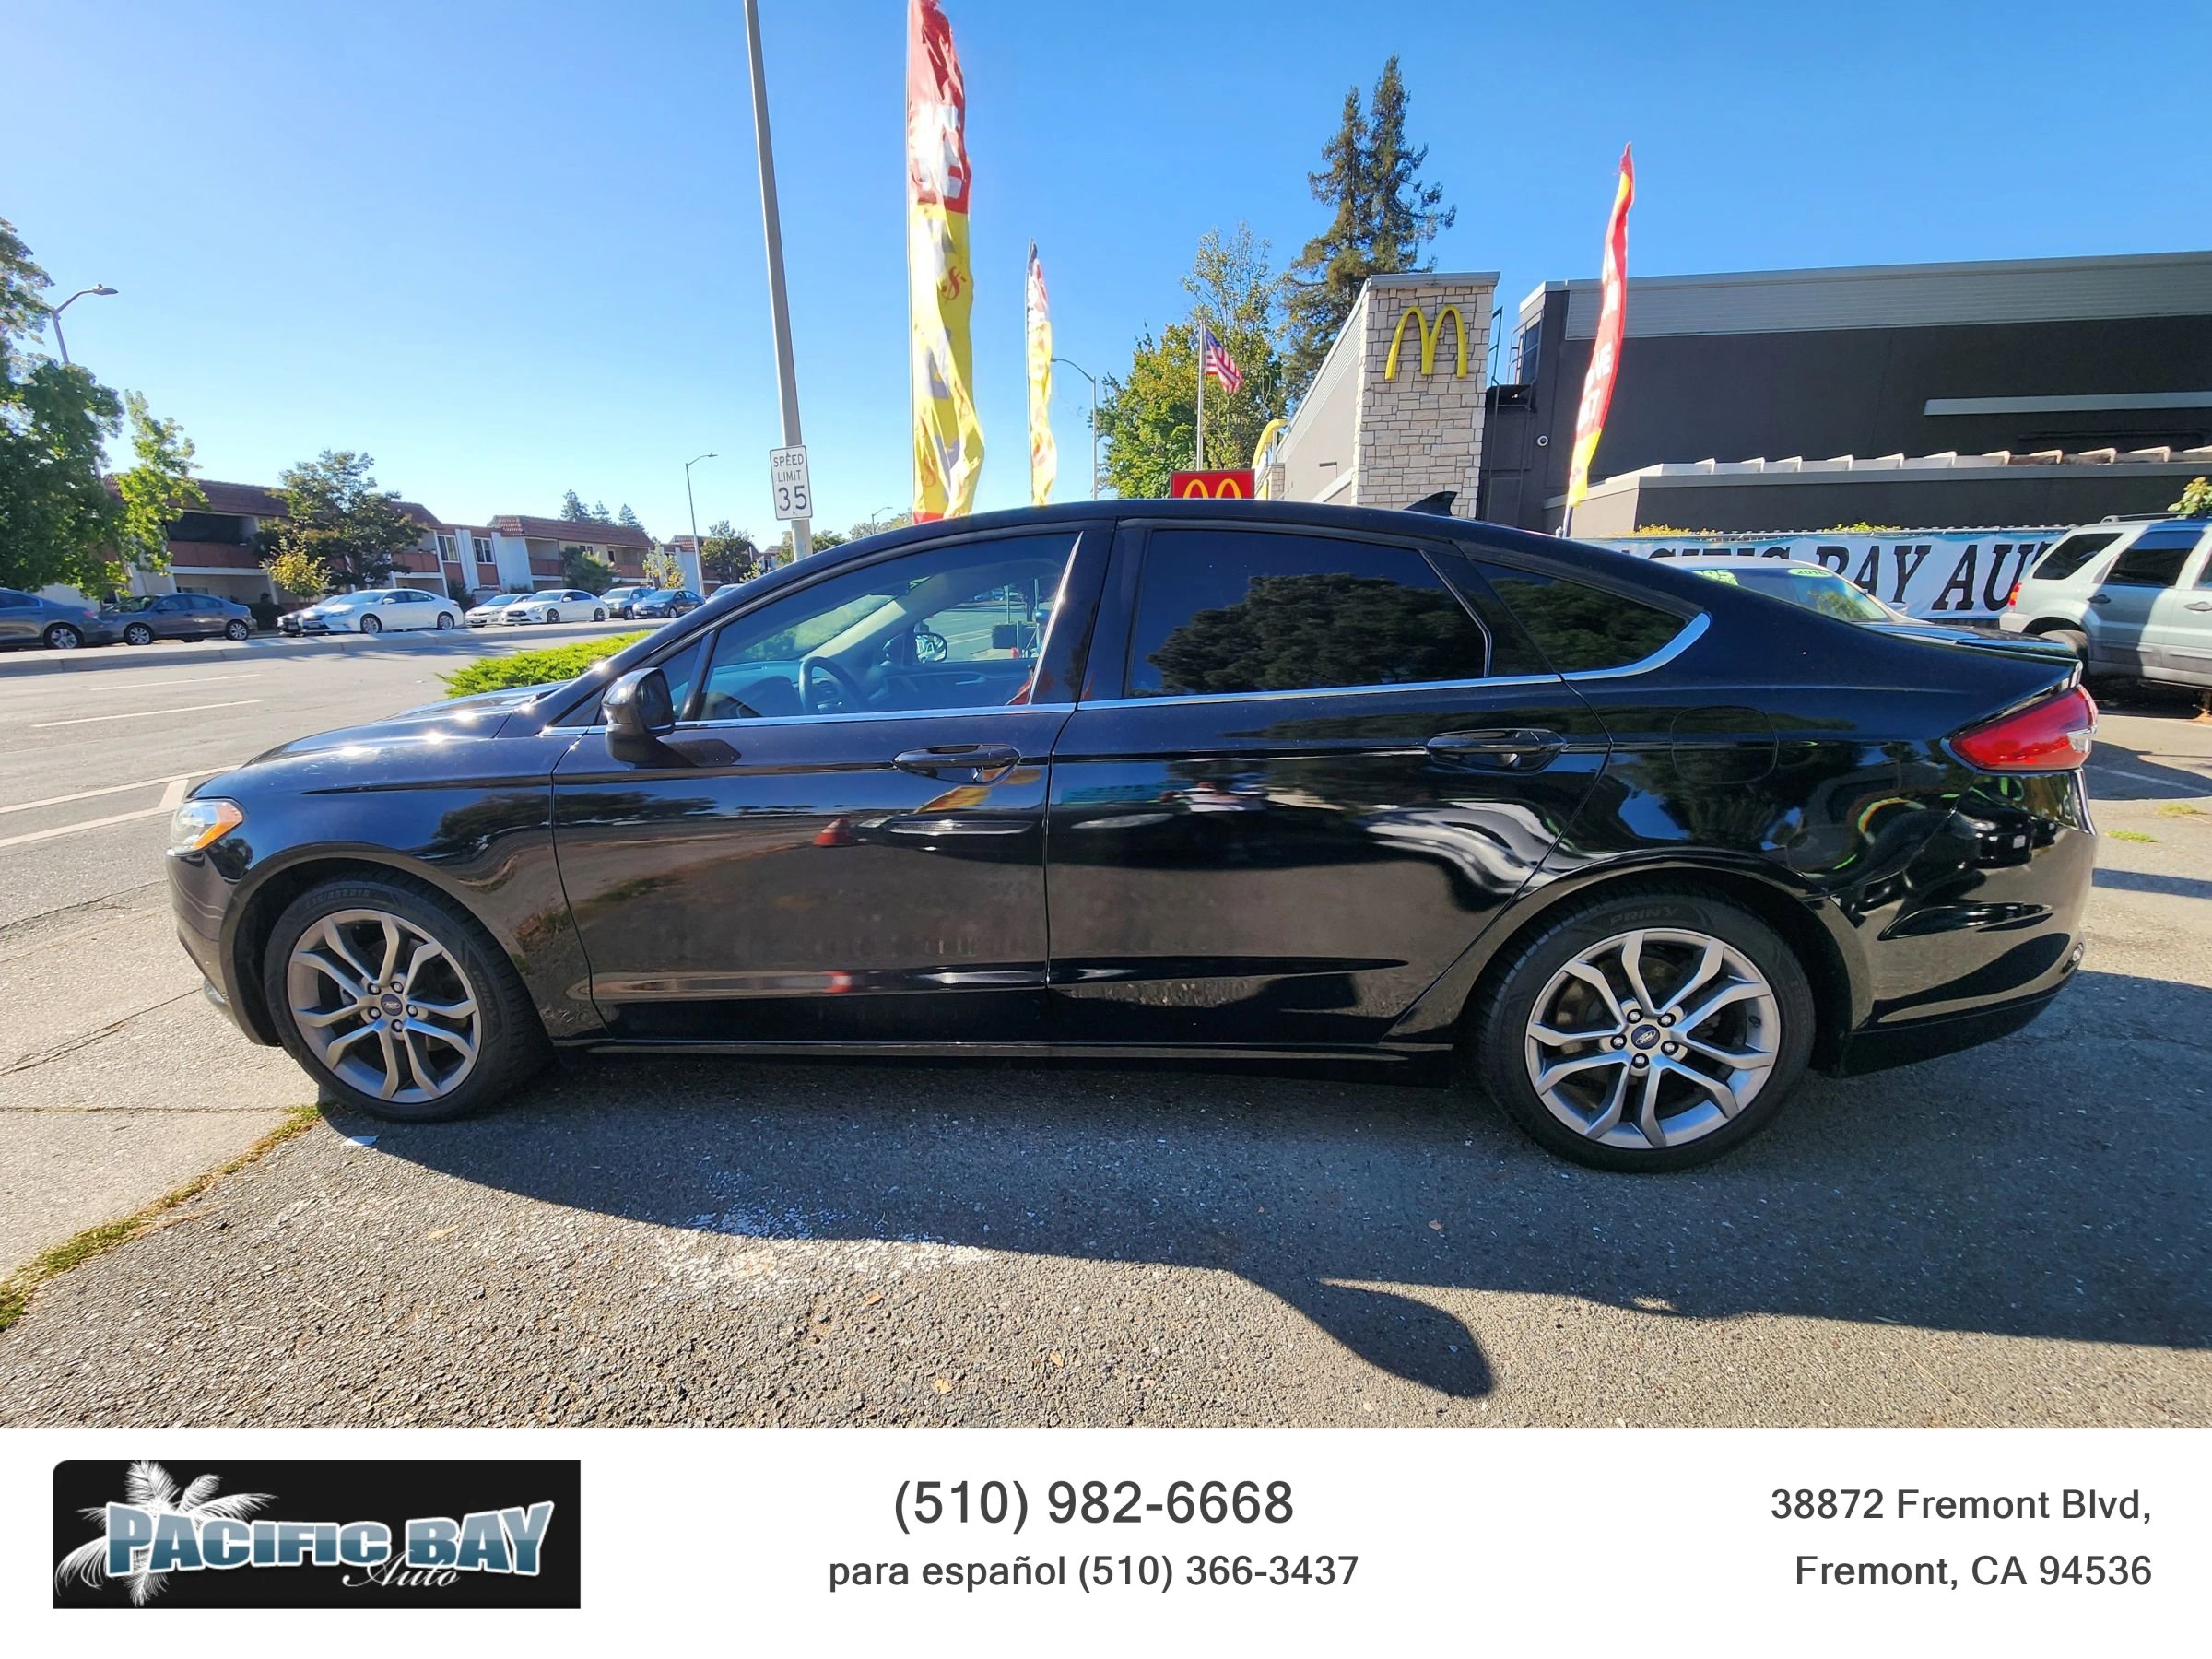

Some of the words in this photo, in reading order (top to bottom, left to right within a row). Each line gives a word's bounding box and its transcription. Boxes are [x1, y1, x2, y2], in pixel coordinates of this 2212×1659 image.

[773, 454, 804, 467] SPEED
[777, 469, 802, 483] LIMIT
[778, 485, 807, 512] 35
[1931, 541, 2055, 612] AU
